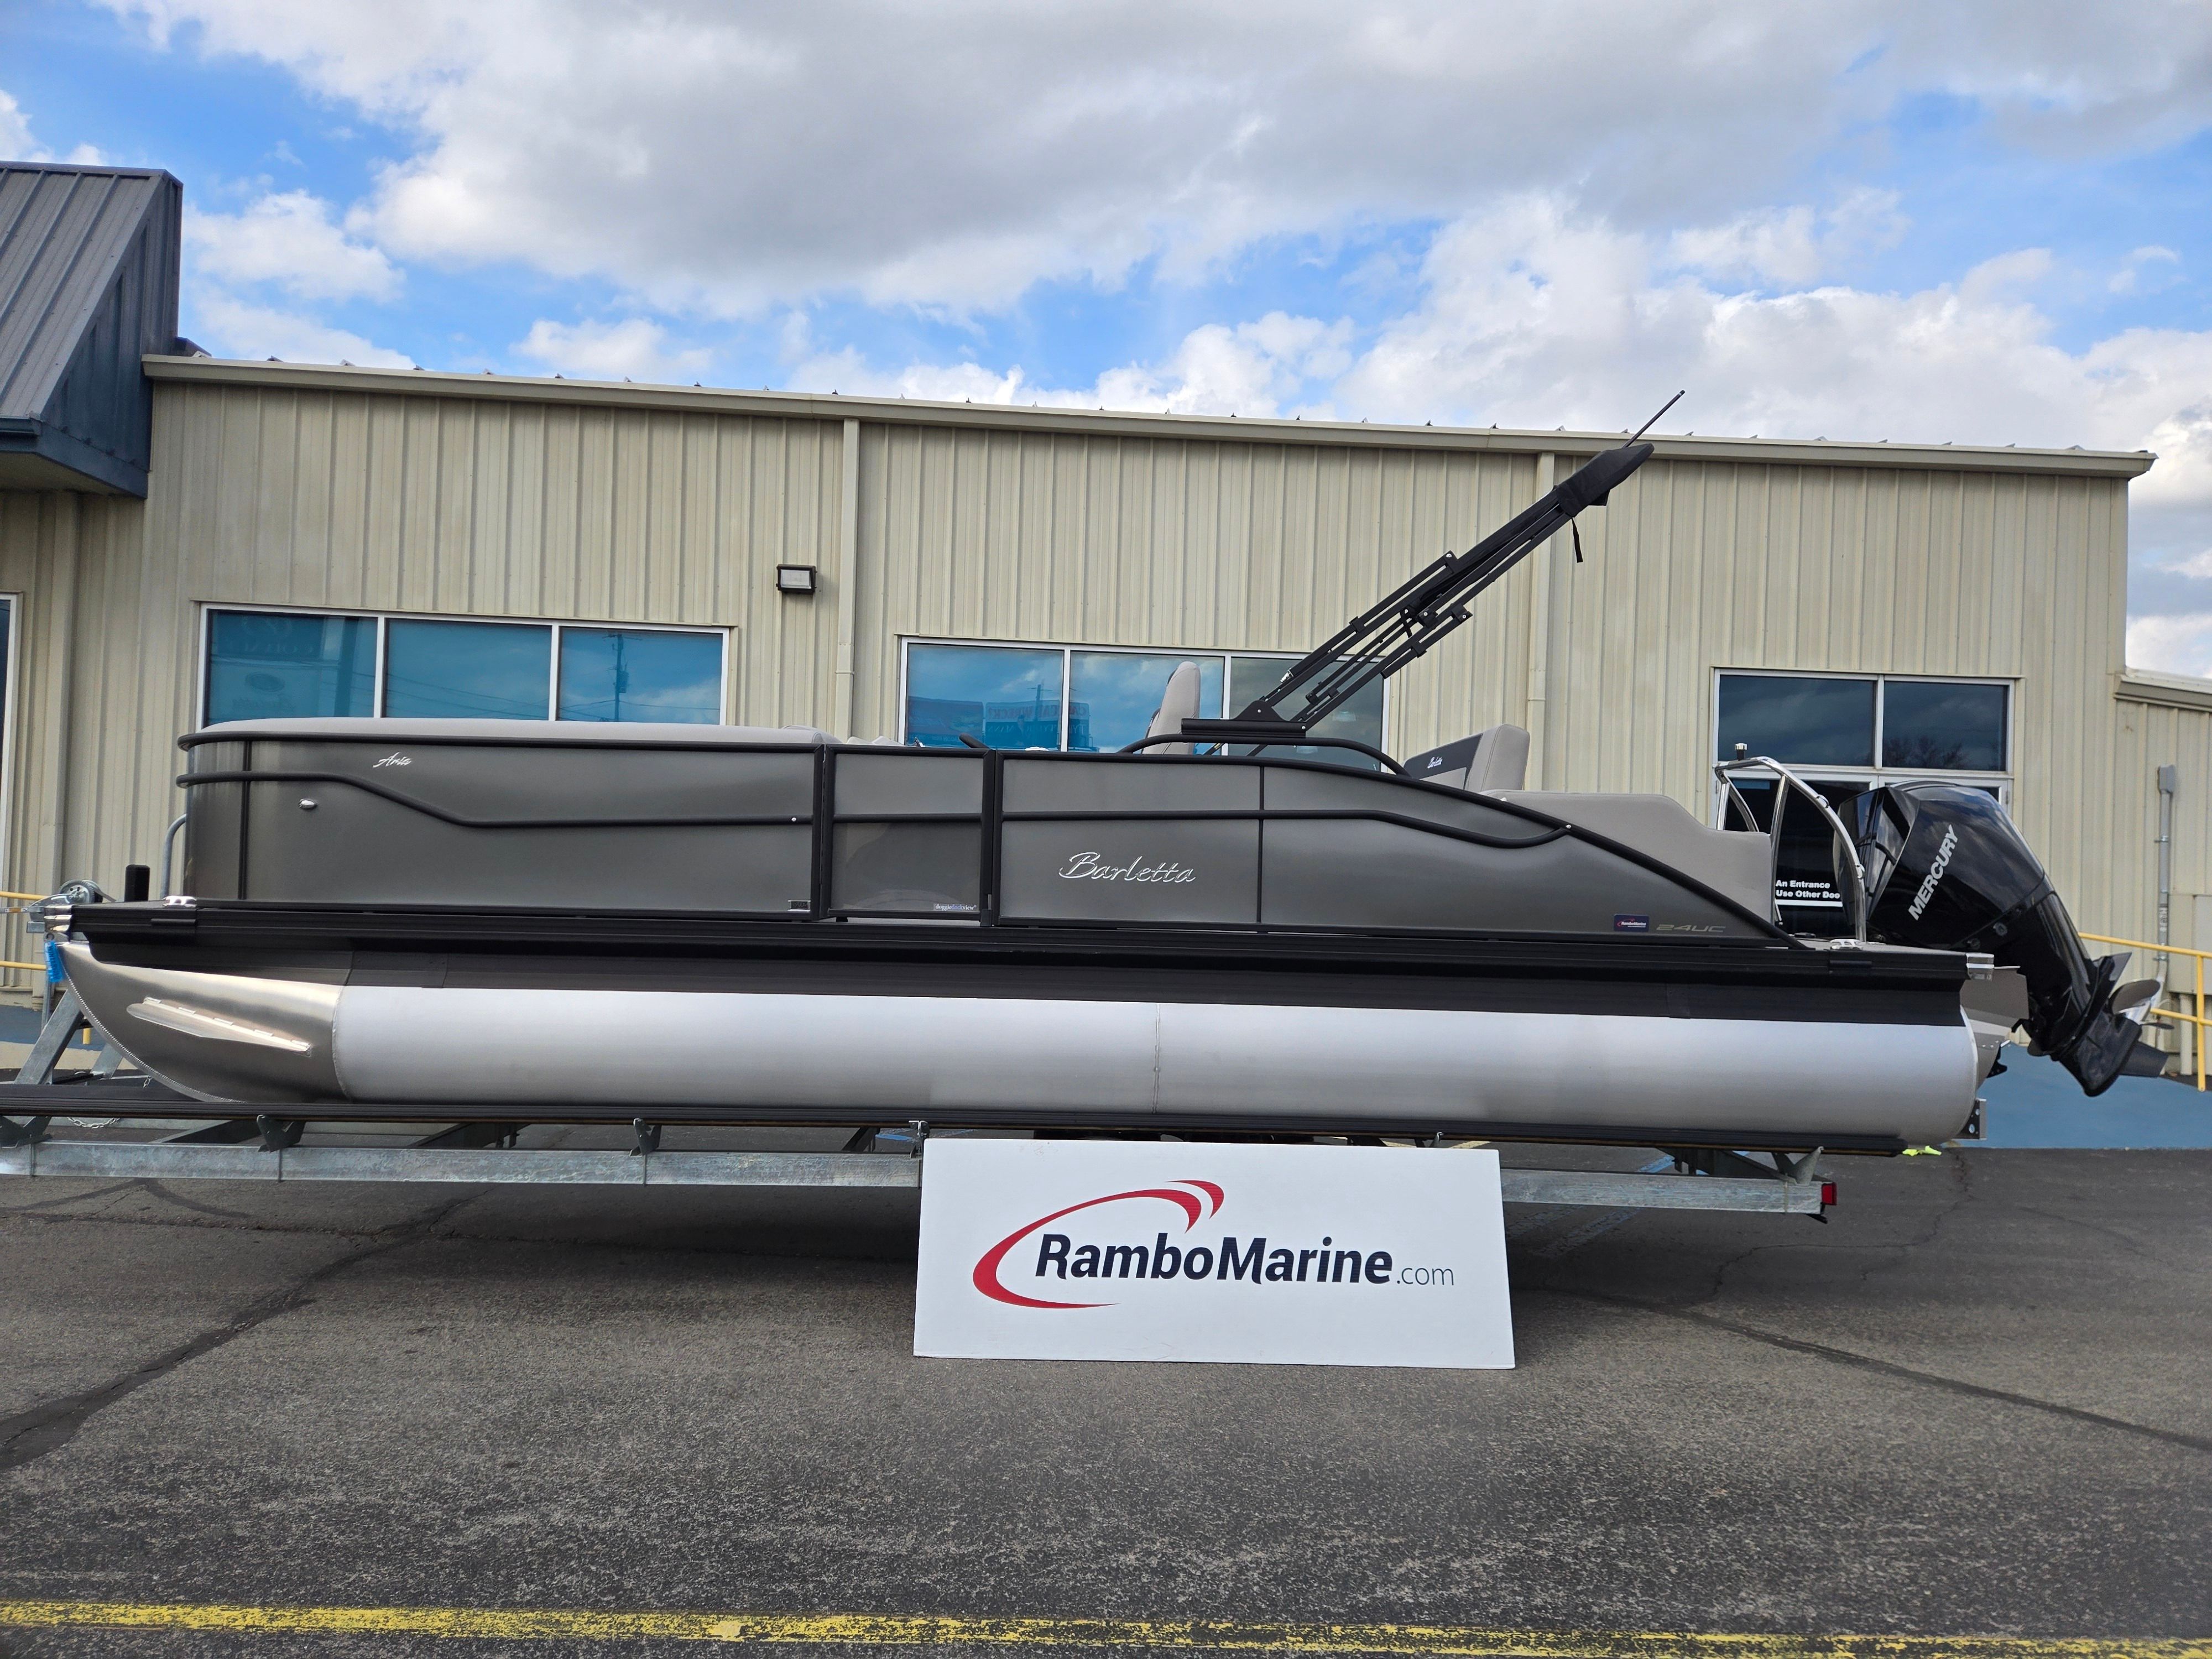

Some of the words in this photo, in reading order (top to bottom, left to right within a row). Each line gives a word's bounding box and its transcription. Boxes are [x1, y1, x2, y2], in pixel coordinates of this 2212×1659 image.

[1058, 852, 1196, 883] Barletta
[1908, 824, 1958, 921] MERCURY
[1790, 880, 1830, 889] Entrance
[1822, 891, 1841, 899] Doo
[1656, 924, 1726, 933] 24UC
[1035, 1233, 1454, 1286] RamboMarine.com
